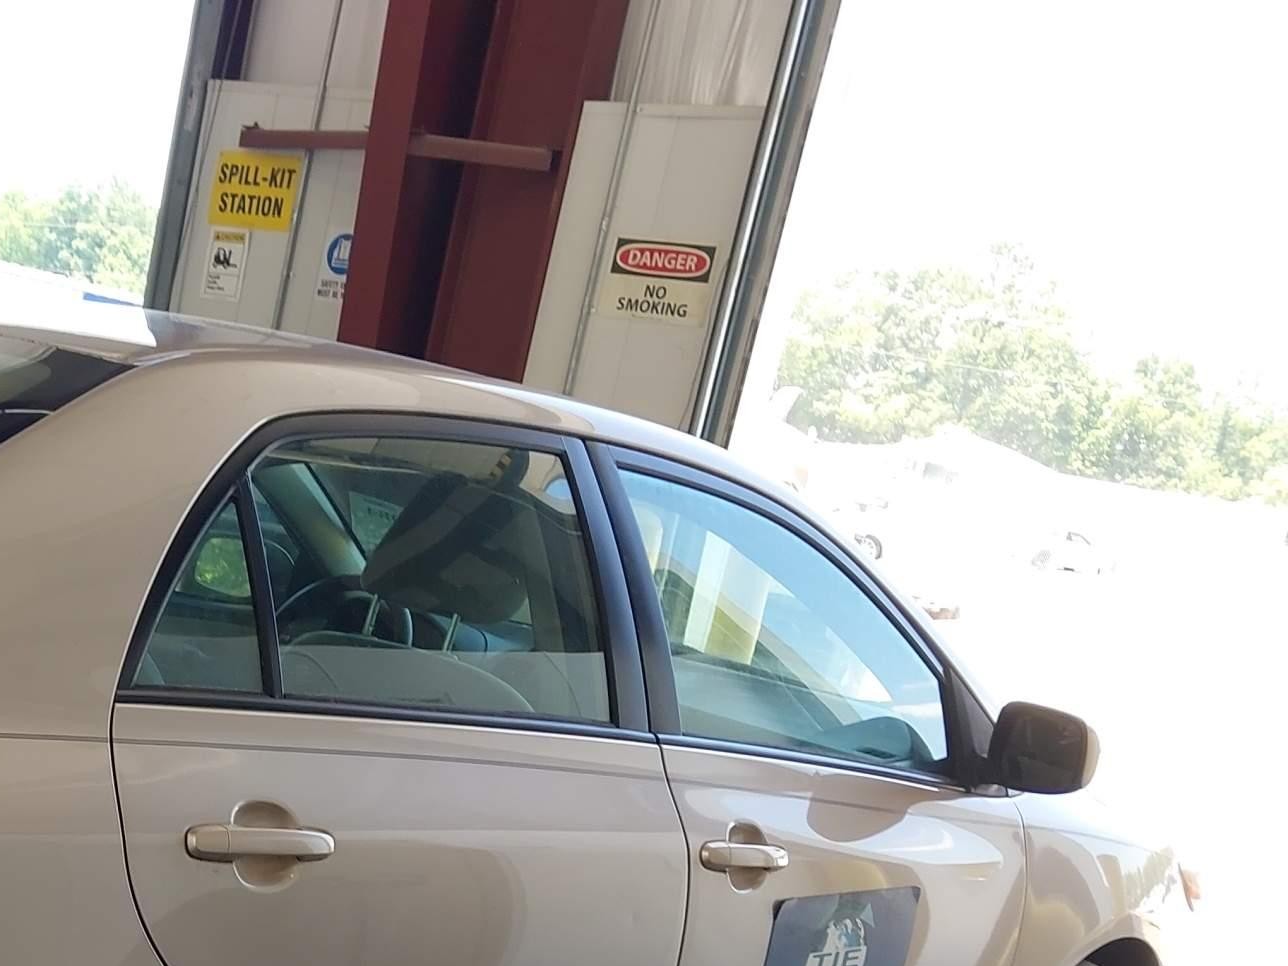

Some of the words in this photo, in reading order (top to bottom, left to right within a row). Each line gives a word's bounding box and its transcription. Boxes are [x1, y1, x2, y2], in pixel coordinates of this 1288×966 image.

[218, 162, 297, 190] SPILL-KIT
[218, 191, 284, 218] STATION
[627, 249, 698, 272] DANGER
[644, 284, 667, 300] NO
[616, 296, 688, 318] SMOKING
